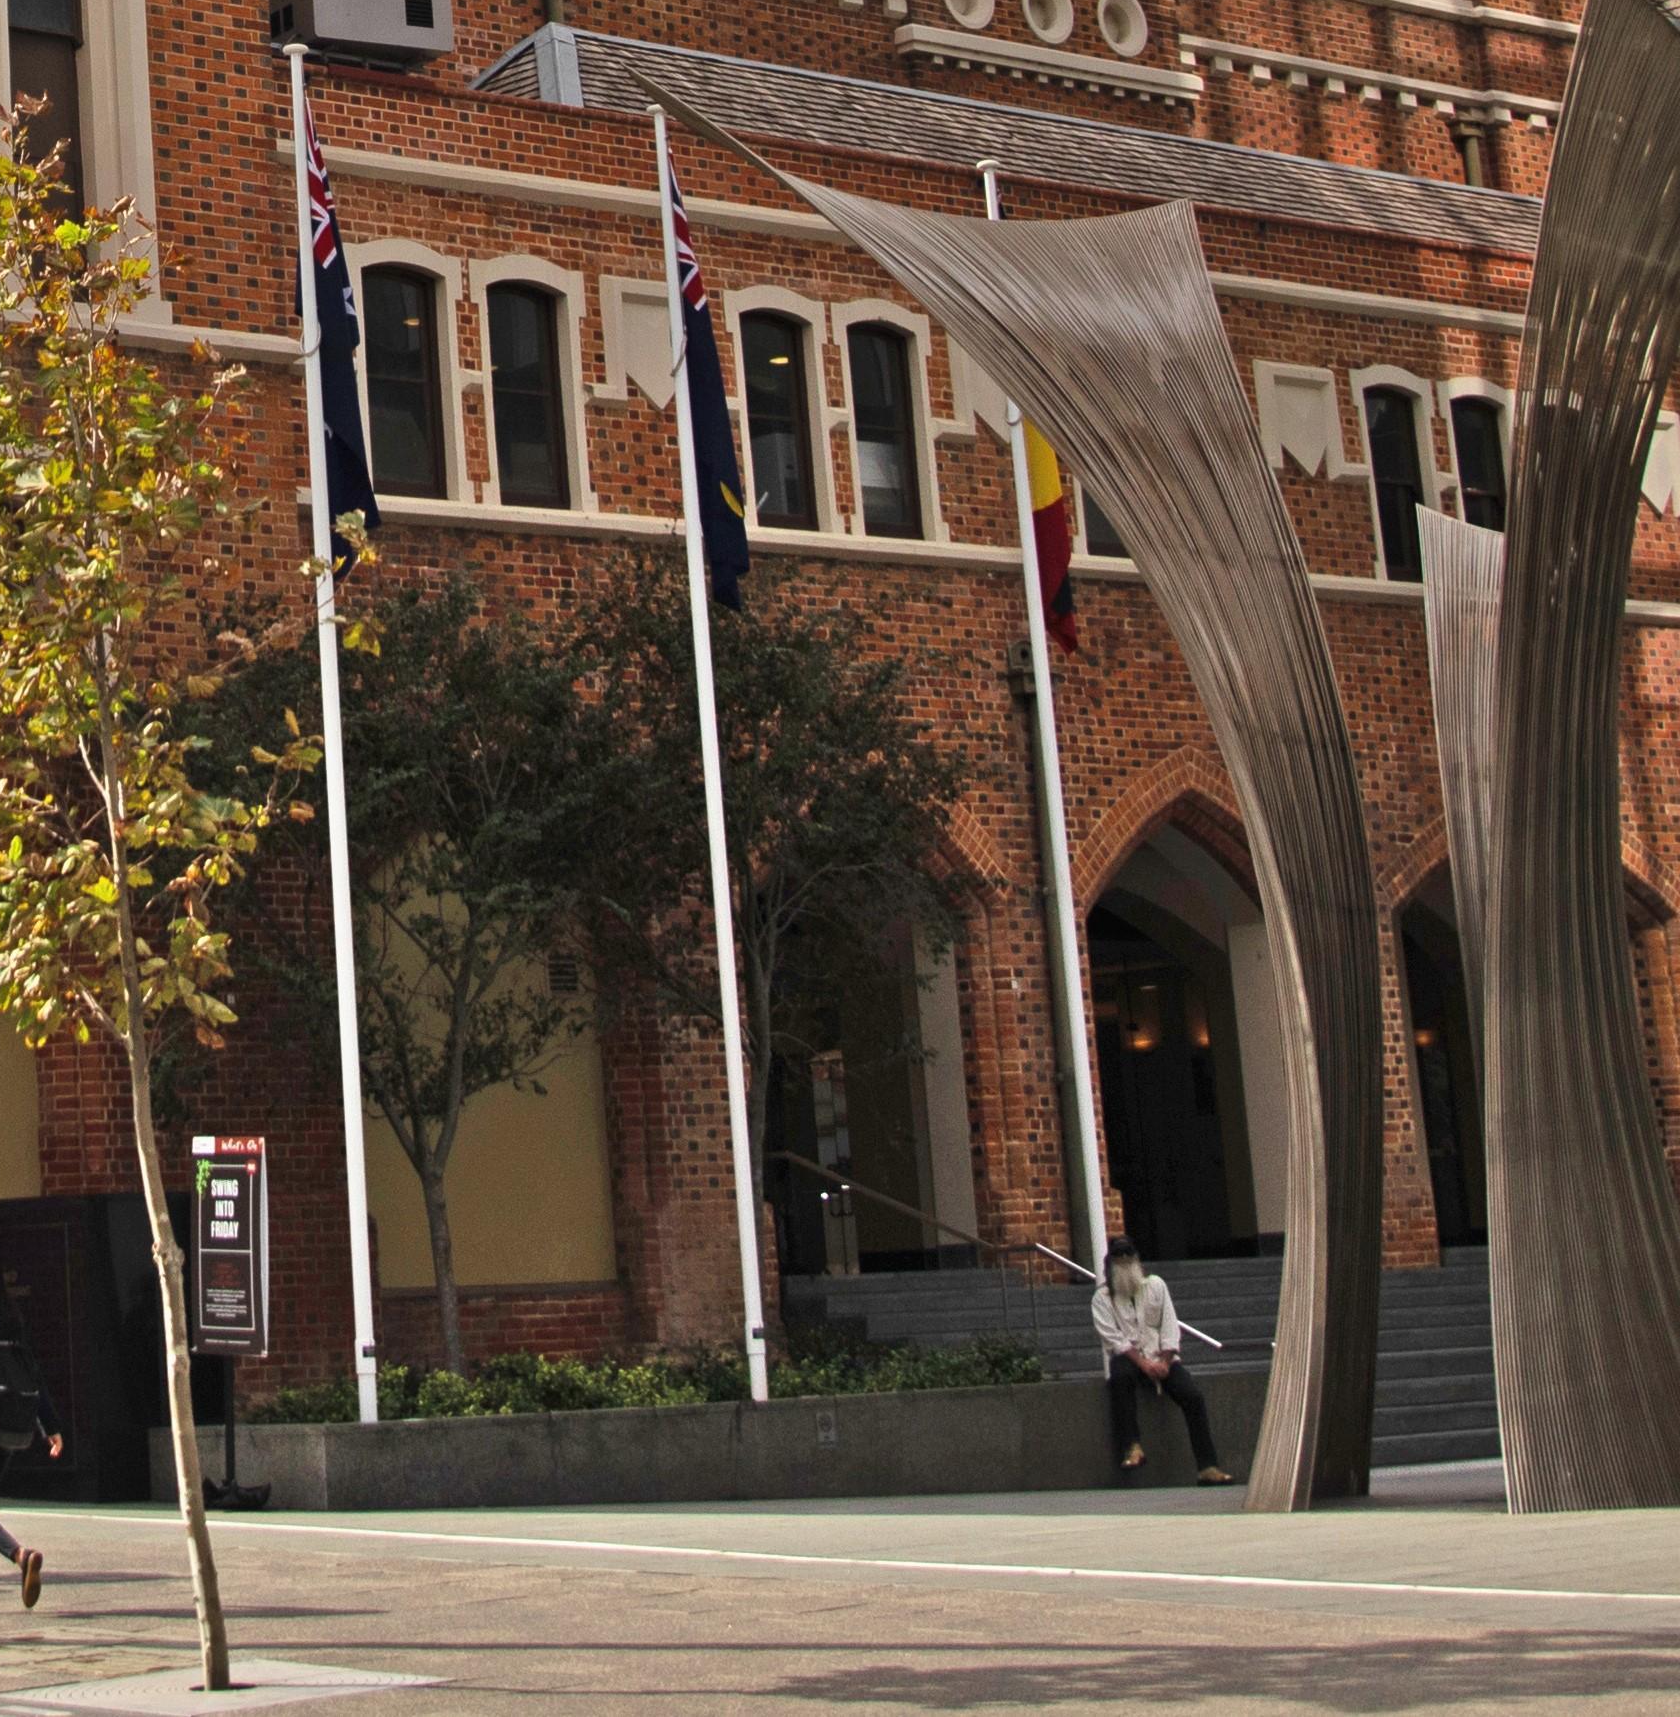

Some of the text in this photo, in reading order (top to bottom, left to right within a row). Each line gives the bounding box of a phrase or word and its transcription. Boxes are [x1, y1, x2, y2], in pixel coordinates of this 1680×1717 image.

[211, 1178, 239, 1197] SWING
[215, 1199, 235, 1219] INTO
[210, 1220, 240, 1240] FRIDAY
